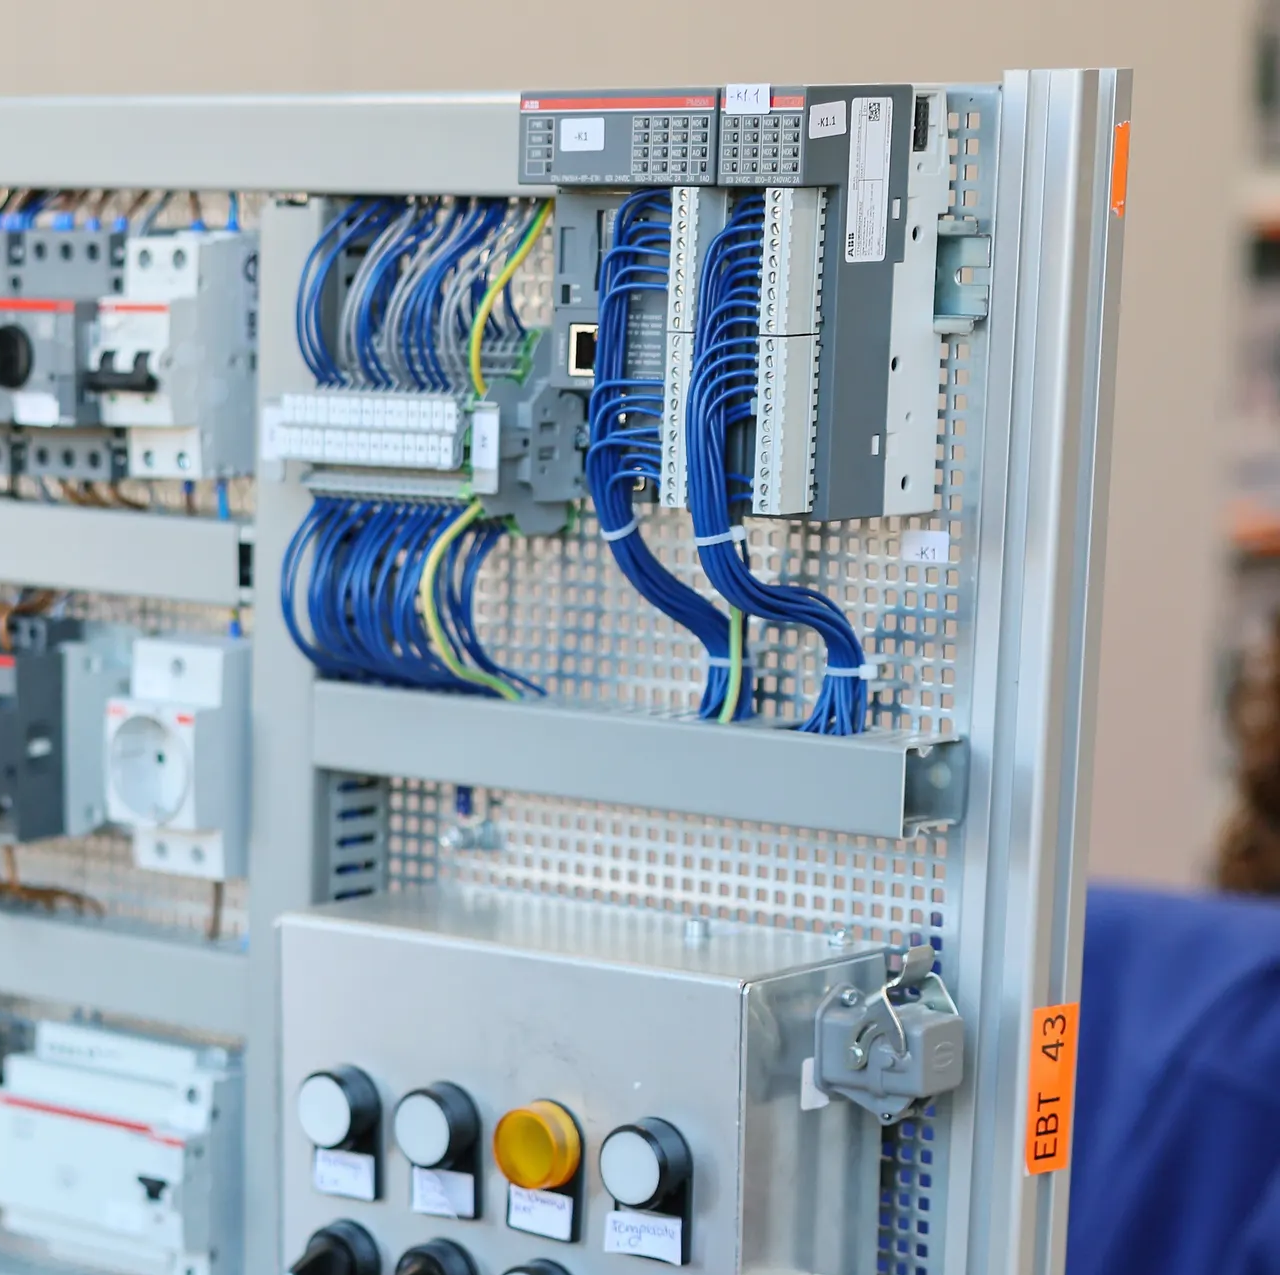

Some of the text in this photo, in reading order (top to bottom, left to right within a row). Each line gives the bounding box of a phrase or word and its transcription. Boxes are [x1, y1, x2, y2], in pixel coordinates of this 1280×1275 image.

[817, 116, 836, 128] -K1.1
[574, 132, 588, 141] -K1
[915, 546, 936, 560] -K1
[1034, 1014, 1067, 1161] EBT 43
